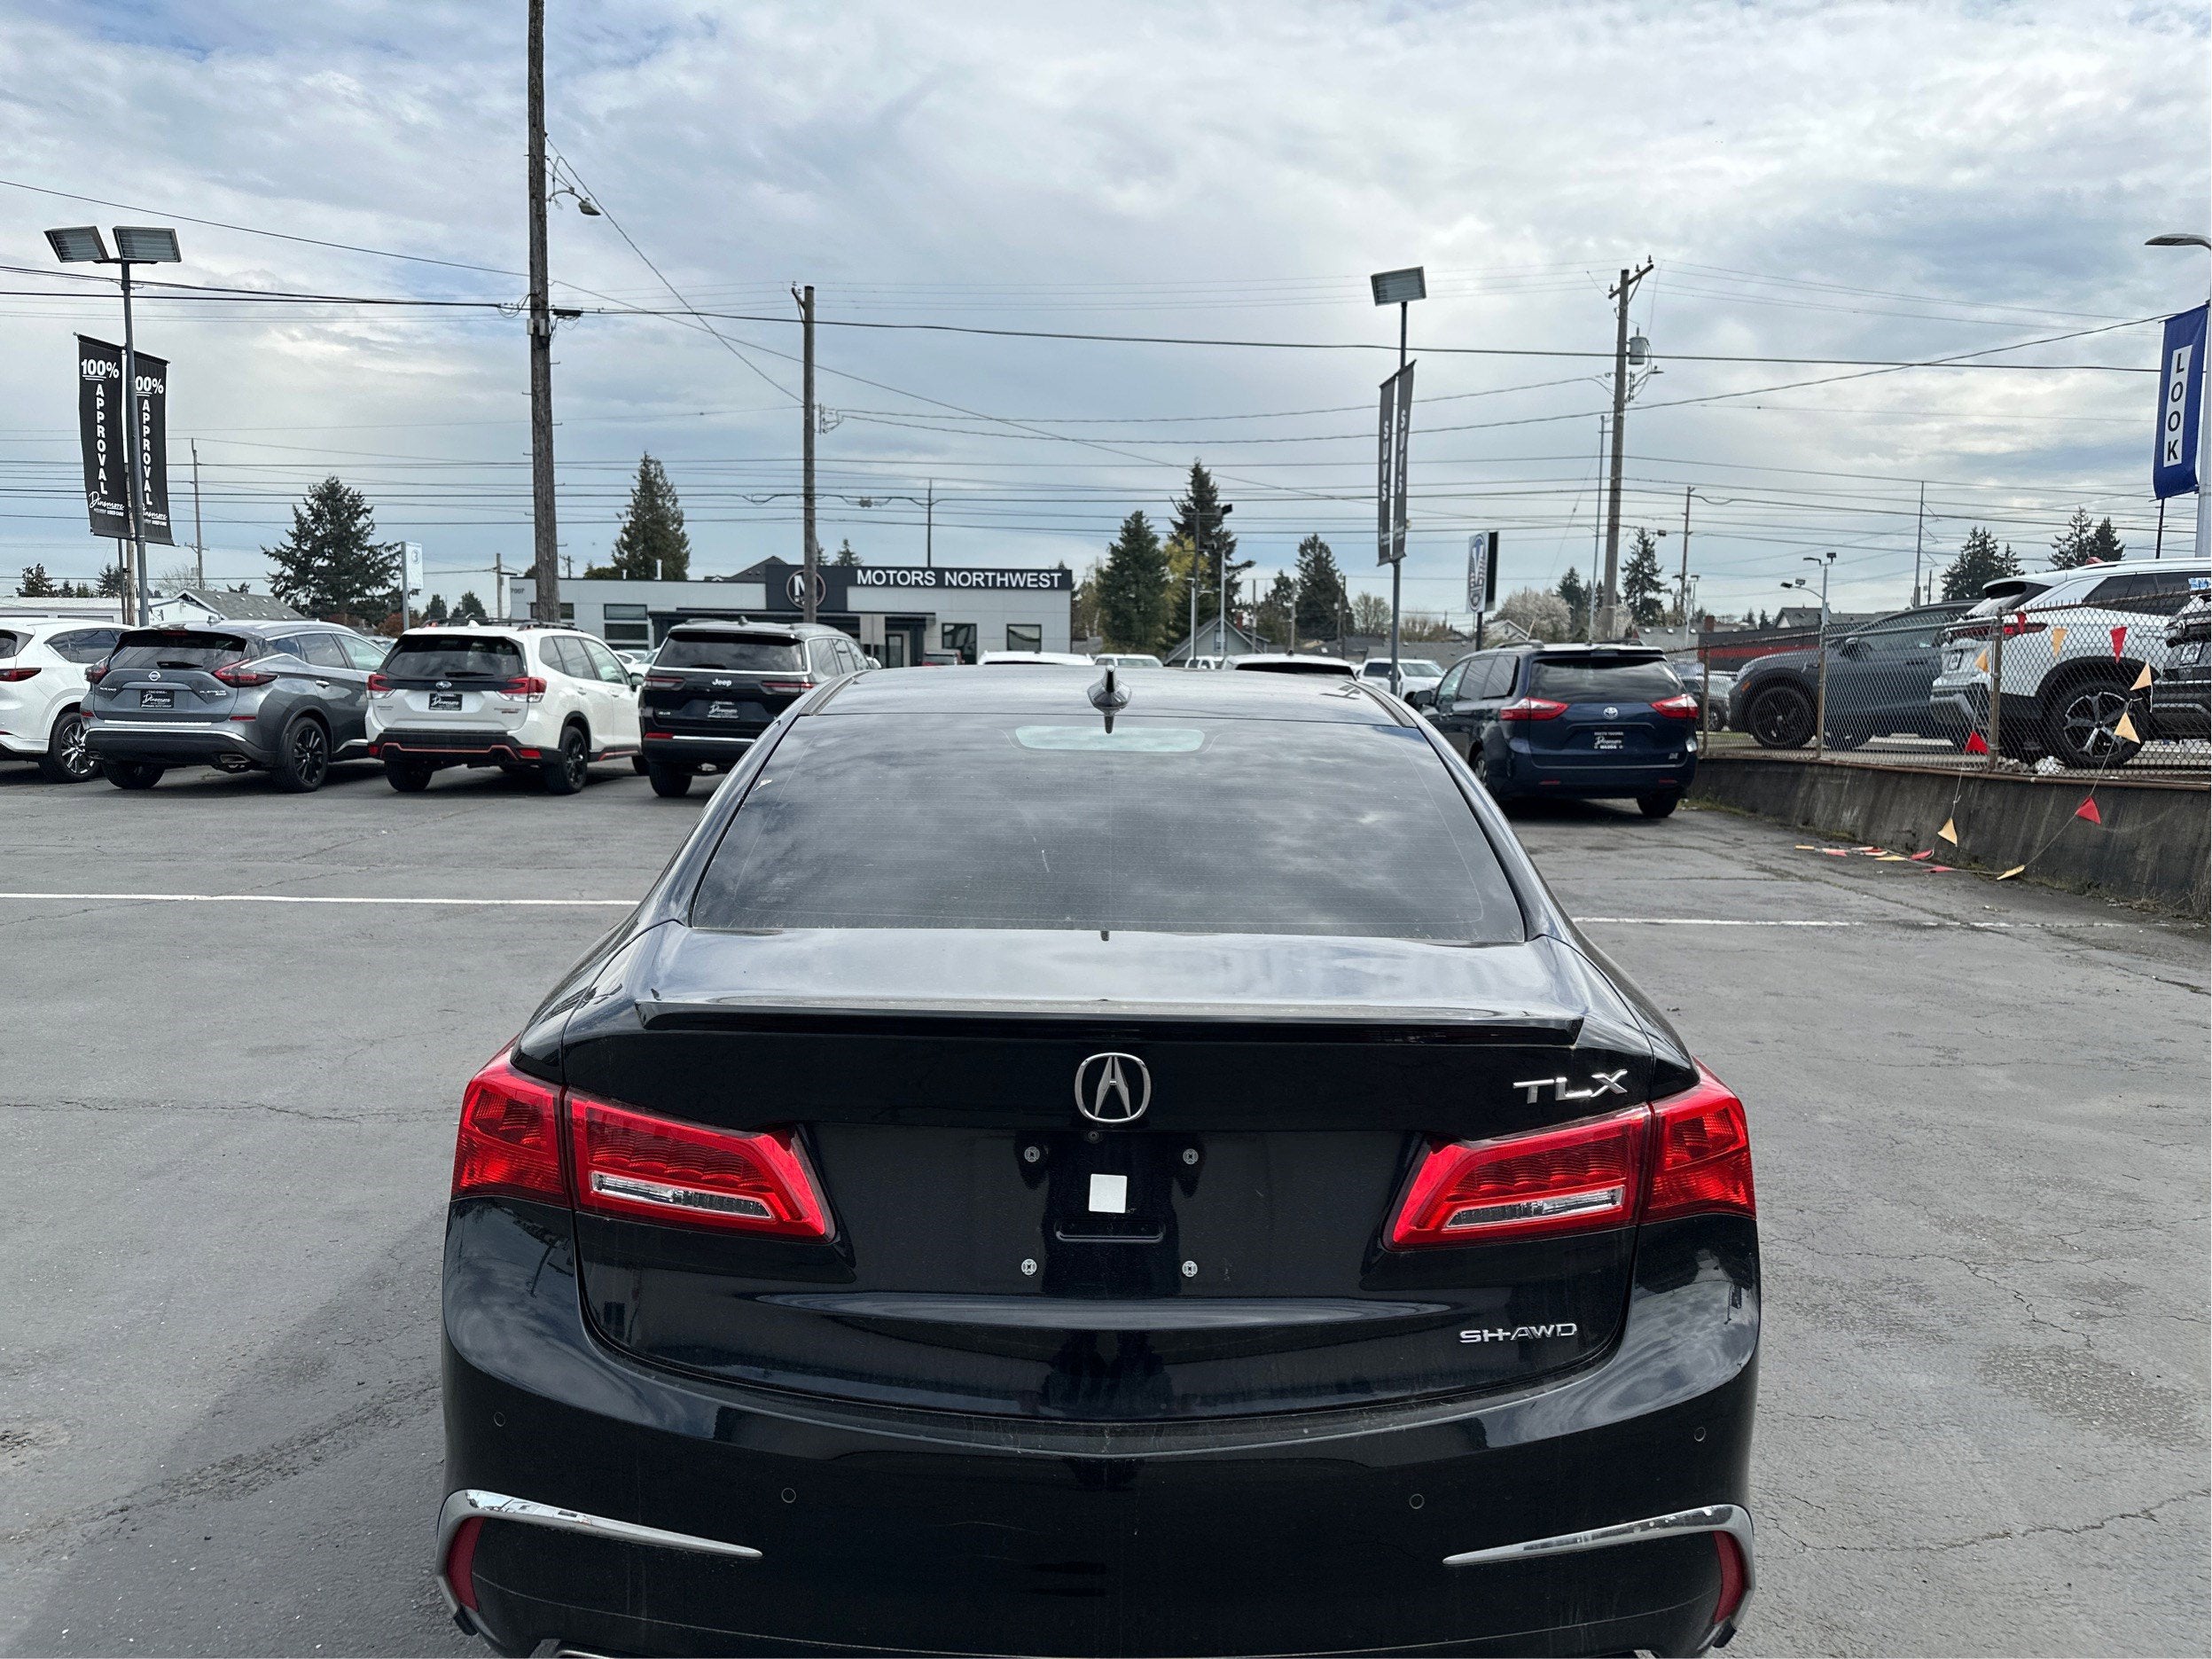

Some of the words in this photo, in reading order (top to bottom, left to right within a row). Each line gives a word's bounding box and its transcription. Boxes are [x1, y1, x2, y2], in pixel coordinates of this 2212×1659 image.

[81, 358, 120, 380] 100%
[135, 375, 164, 395] 00%
[2166, 352, 2185, 462] LOOK
[96, 383, 108, 495] APPROVAL
[142, 399, 153, 505] APPROVAL
[856, 568, 936, 587] MOTORS
[944, 570, 1062, 589] NORTHWEST
[711, 677, 732, 687] Jeep
[1512, 1068, 1629, 1105] TLX
